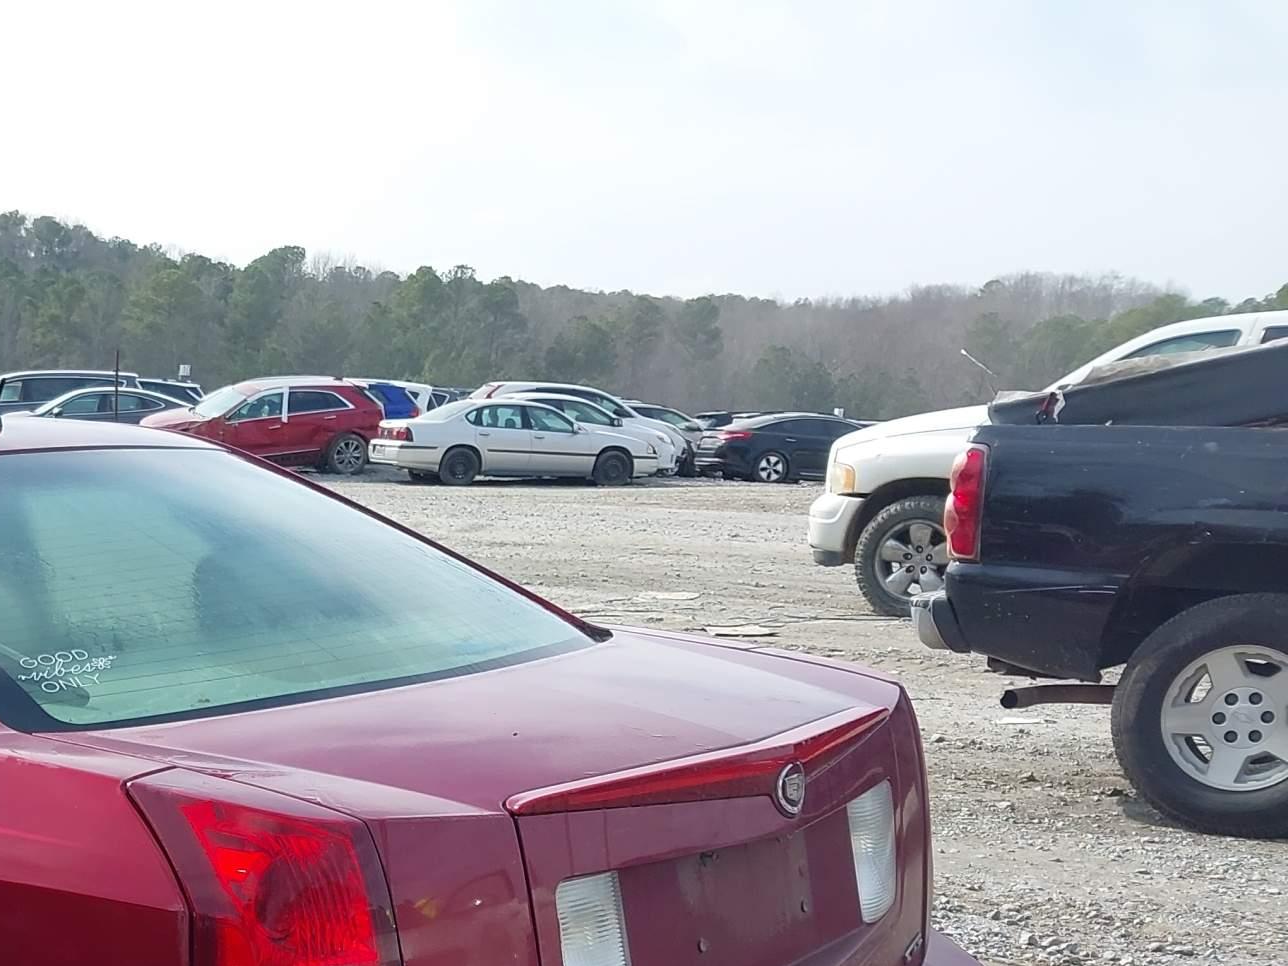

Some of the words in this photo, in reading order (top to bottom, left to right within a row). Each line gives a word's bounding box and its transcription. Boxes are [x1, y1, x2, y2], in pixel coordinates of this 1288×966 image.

[17, 658, 96, 681] vibes
[19, 649, 88, 669] GOOD
[41, 672, 101, 693] ONLY
